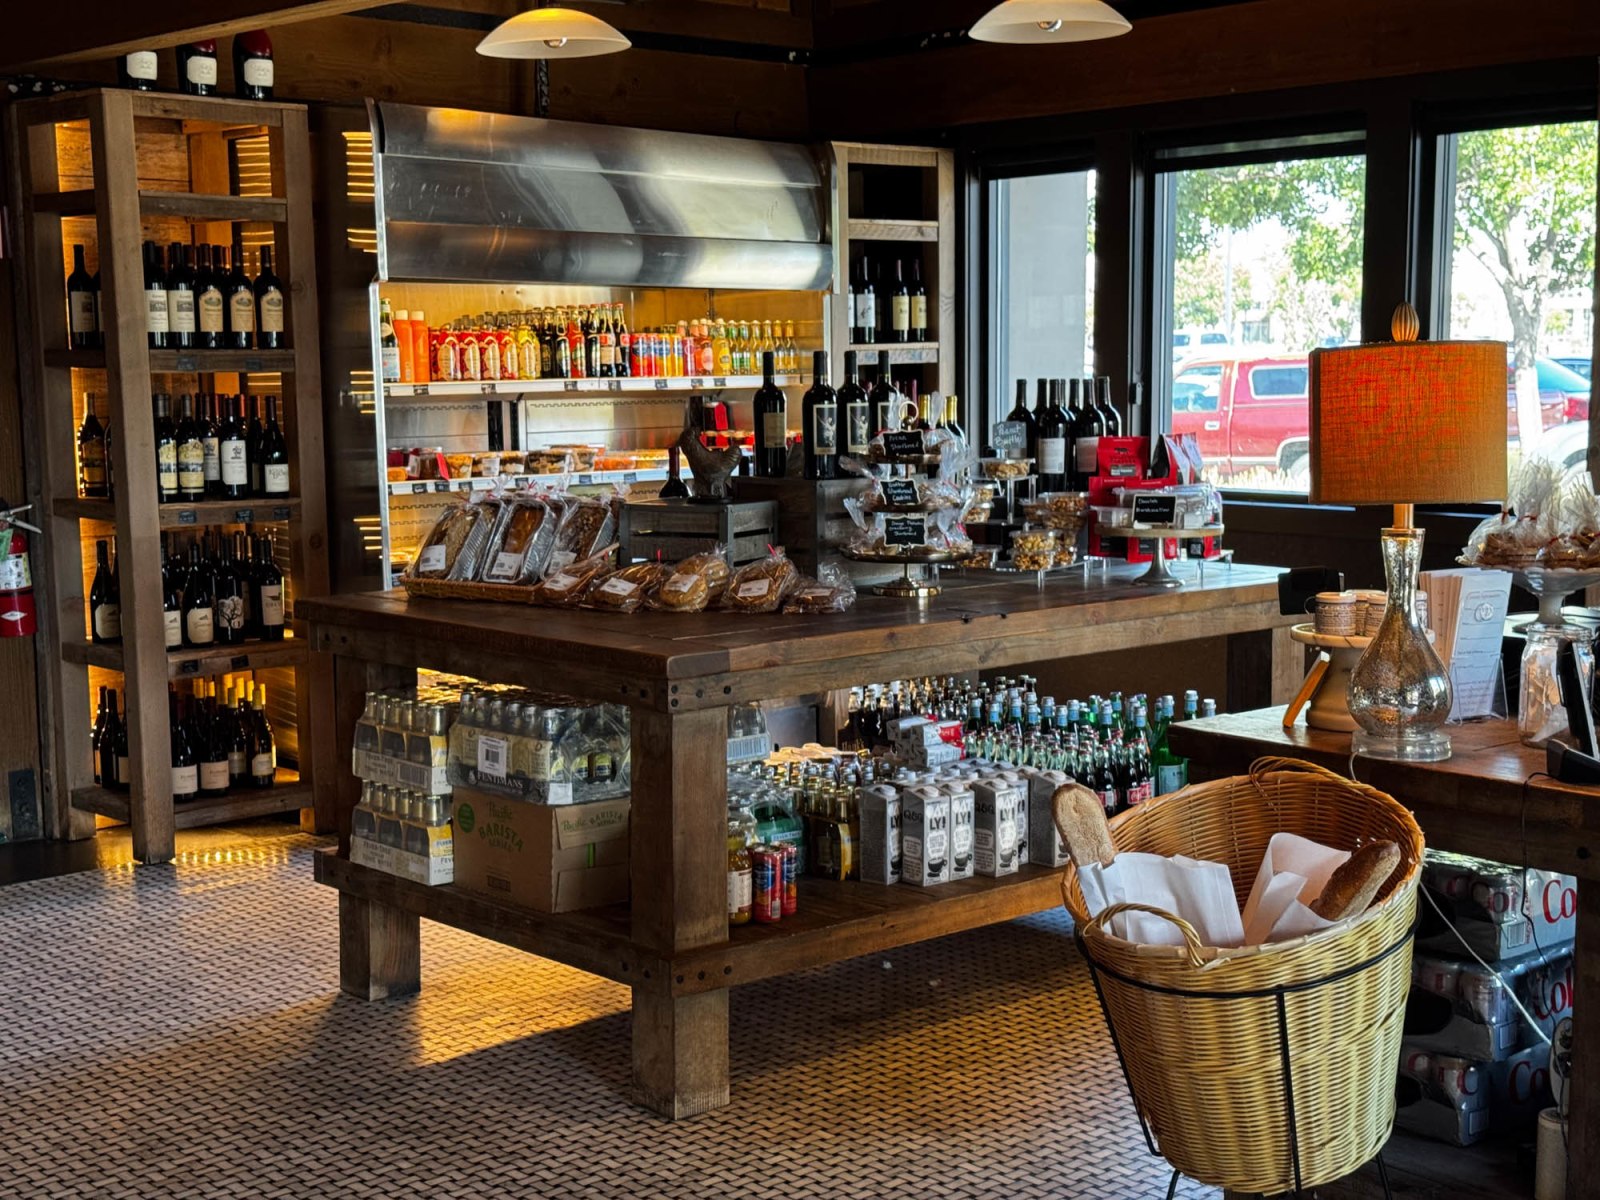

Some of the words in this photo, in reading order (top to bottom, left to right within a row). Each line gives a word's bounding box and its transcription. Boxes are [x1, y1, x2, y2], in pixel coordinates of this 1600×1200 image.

[956, 811, 971, 825] LY!
[1000, 807, 1015, 821] LY!
[930, 816, 946, 830] LY!
[479, 821, 524, 852] BARISTA
